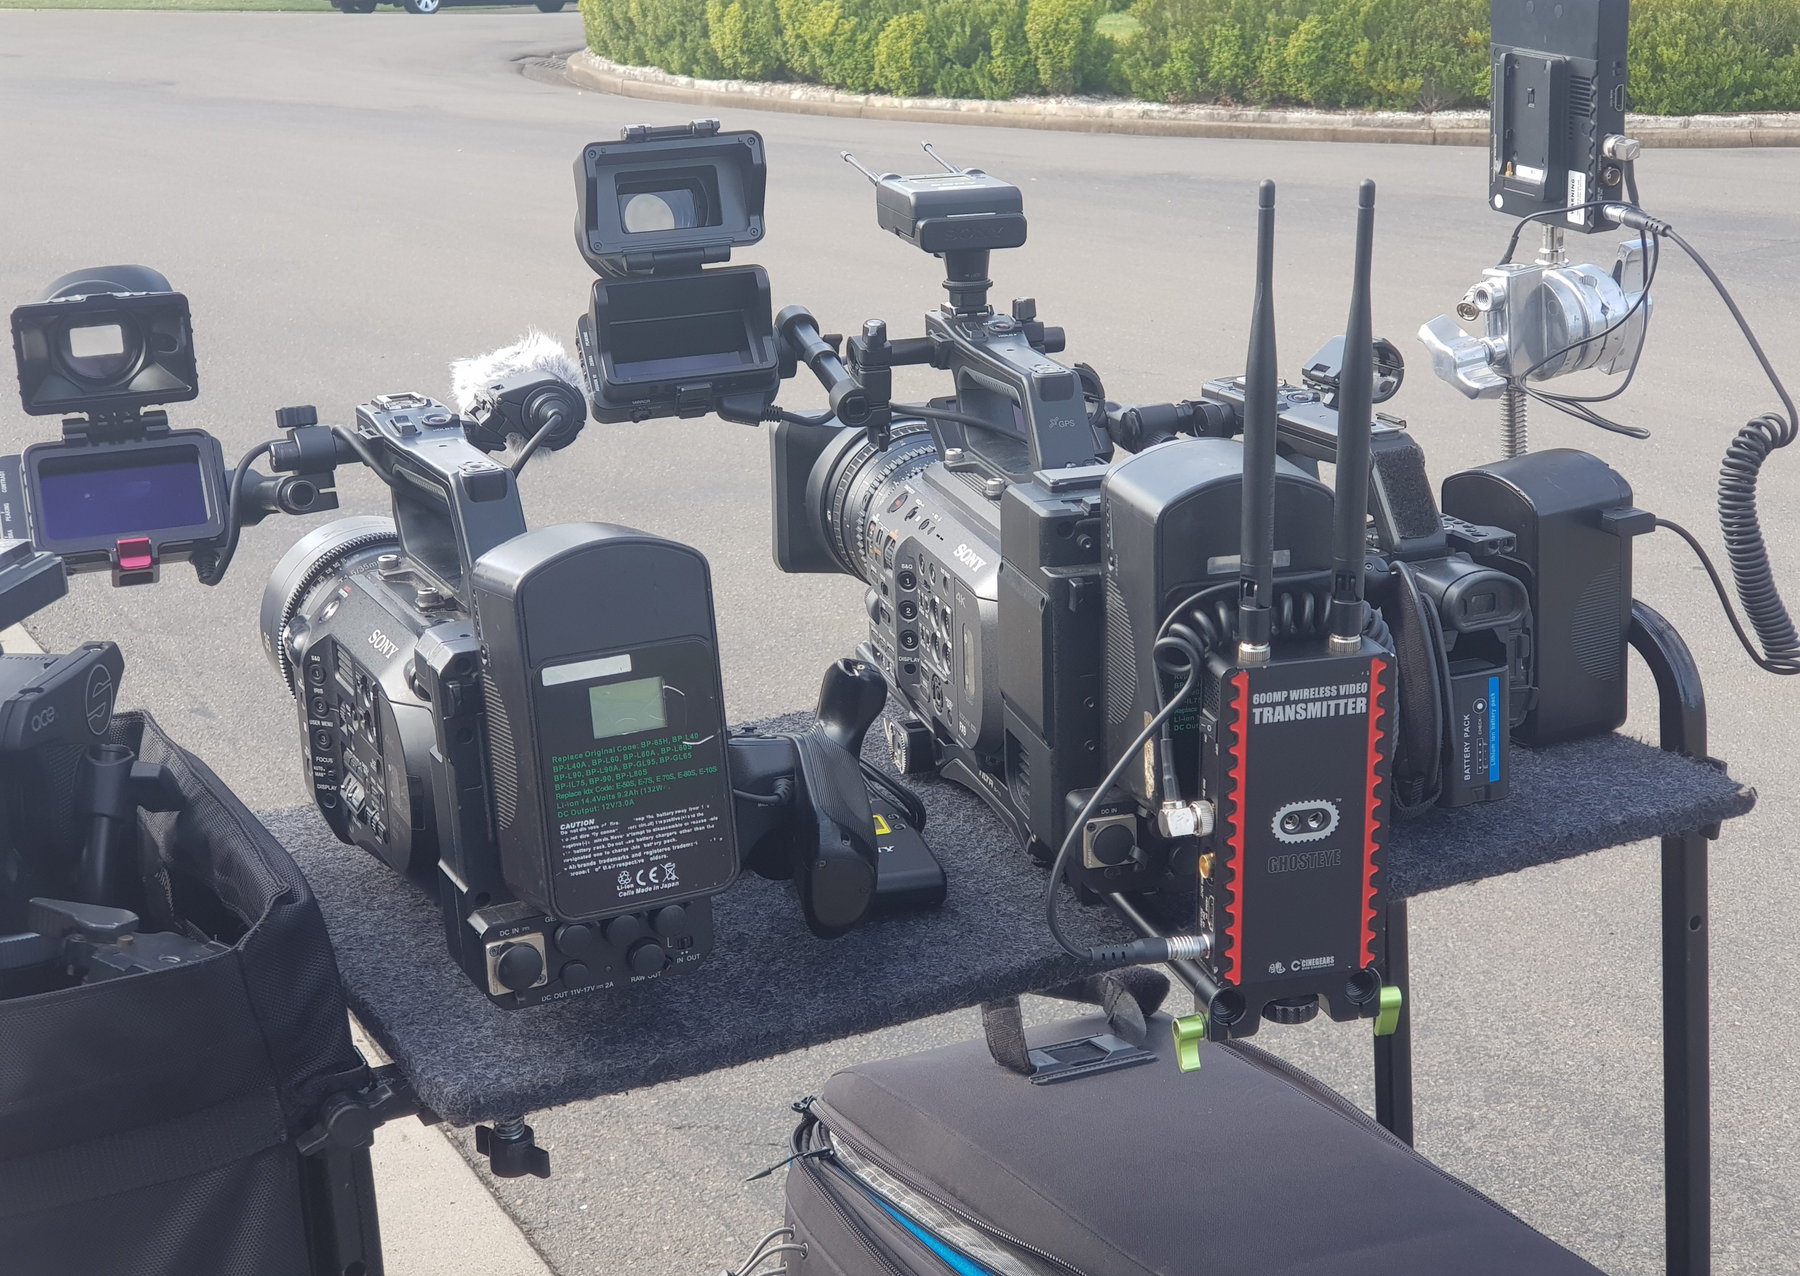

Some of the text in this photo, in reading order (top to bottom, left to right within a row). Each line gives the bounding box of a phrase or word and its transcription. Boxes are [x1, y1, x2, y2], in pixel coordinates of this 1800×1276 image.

[1058, 419, 1076, 428] GPS
[953, 543, 987, 573] SONY
[368, 629, 399, 659] SONY
[1252, 682, 1368, 705] 600MP WIRELESS VIDEO
[32, 706, 56, 732] ace
[1252, 697, 1368, 725] TRANSMITTER
[552, 753, 583, 763] Replace
[585, 746, 615, 758] Original
[1463, 713, 1471, 781] BATTERY PACK
[316, 756, 334, 764] FOCUS
[316, 783, 338, 791] DISPLAY
[556, 790, 582, 800] Replace
[571, 804, 600, 817] Output:
[602, 799, 635, 810] 12V/3.0A
[560, 819, 595, 830] CAUTION
[1267, 848, 1341, 874] GHOSTEYE
[635, 886, 652, 895] Made
[660, 881, 680, 890] Japan
[499, 928, 511, 937] DC
[686, 953, 700, 961] OUT
[1301, 956, 1335, 968] CINEGEARS
[553, 990, 569, 1000] OUT
[570, 983, 595, 995] 11V-17V
[605, 981, 615, 989] 2A
